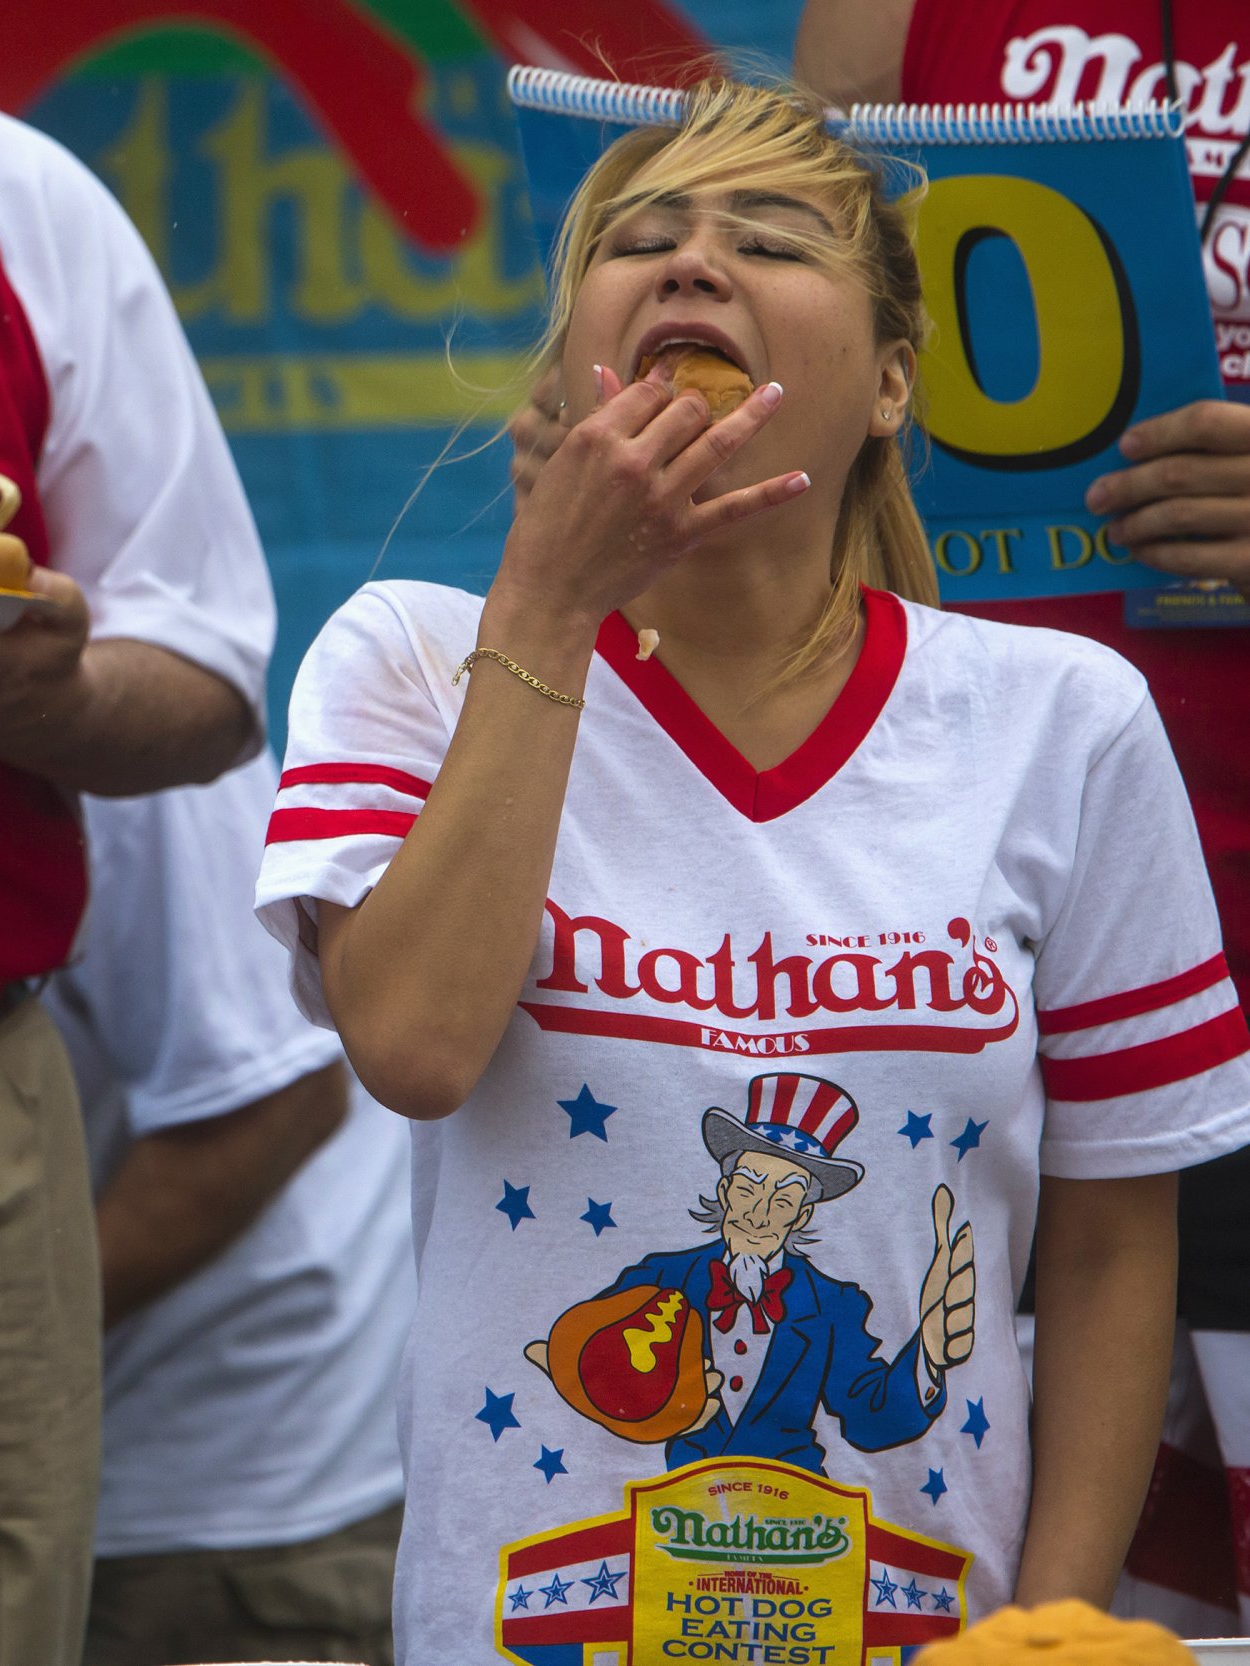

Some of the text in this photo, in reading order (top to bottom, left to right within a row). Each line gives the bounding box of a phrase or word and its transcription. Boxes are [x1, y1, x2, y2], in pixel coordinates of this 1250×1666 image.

[806, 931, 926, 948] SINCE 1916
[701, 1028, 810, 1054] FAMOUS
[708, 1482, 789, 1500] SINCE 1916
[651, 1507, 849, 1550] Nathan's
[696, 1577, 803, 1595] INTERNATIONAL
[666, 1592, 832, 1619] HOT DOG
[681, 1618, 816, 1642] EATING
[662, 1639, 835, 1665] CONTEST
